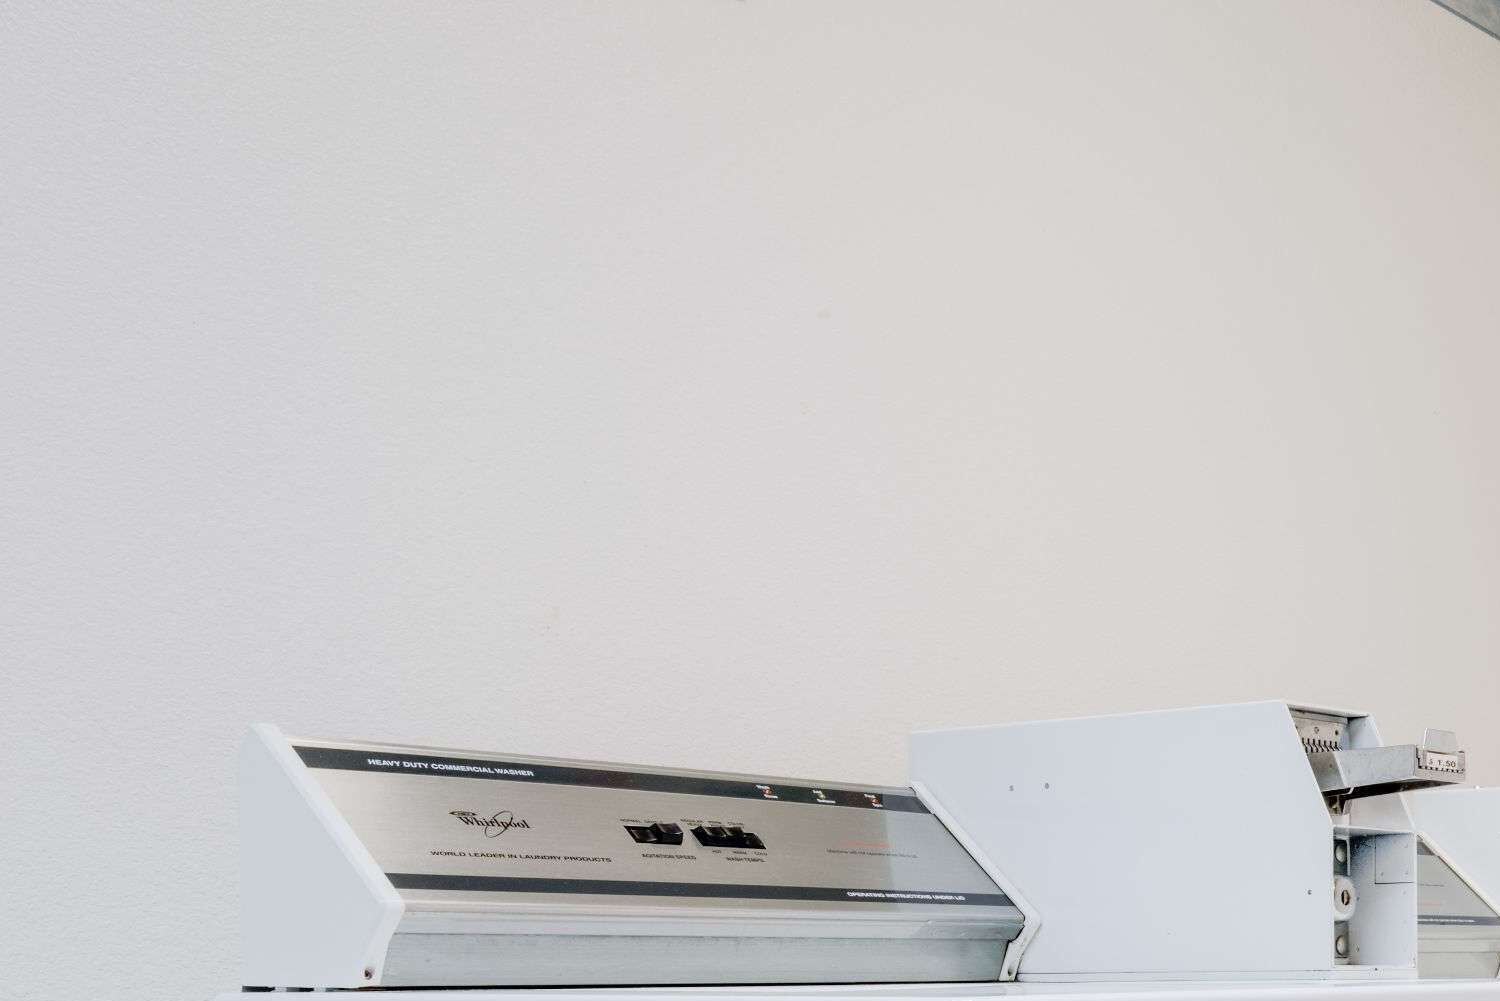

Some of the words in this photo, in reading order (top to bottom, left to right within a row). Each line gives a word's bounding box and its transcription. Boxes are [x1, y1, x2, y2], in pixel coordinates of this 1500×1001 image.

[367, 758, 400, 767] HEAVY
[402, 761, 429, 769] DUTY
[431, 763, 494, 774] COMMERCIAL
[494, 767, 535, 777] WASHER
[457, 814, 531, 833] Whirlpool
[468, 851, 506, 859] LEADER
[519, 853, 561, 861] LAUNDRY
[563, 855, 612, 863] PRODUCTS
